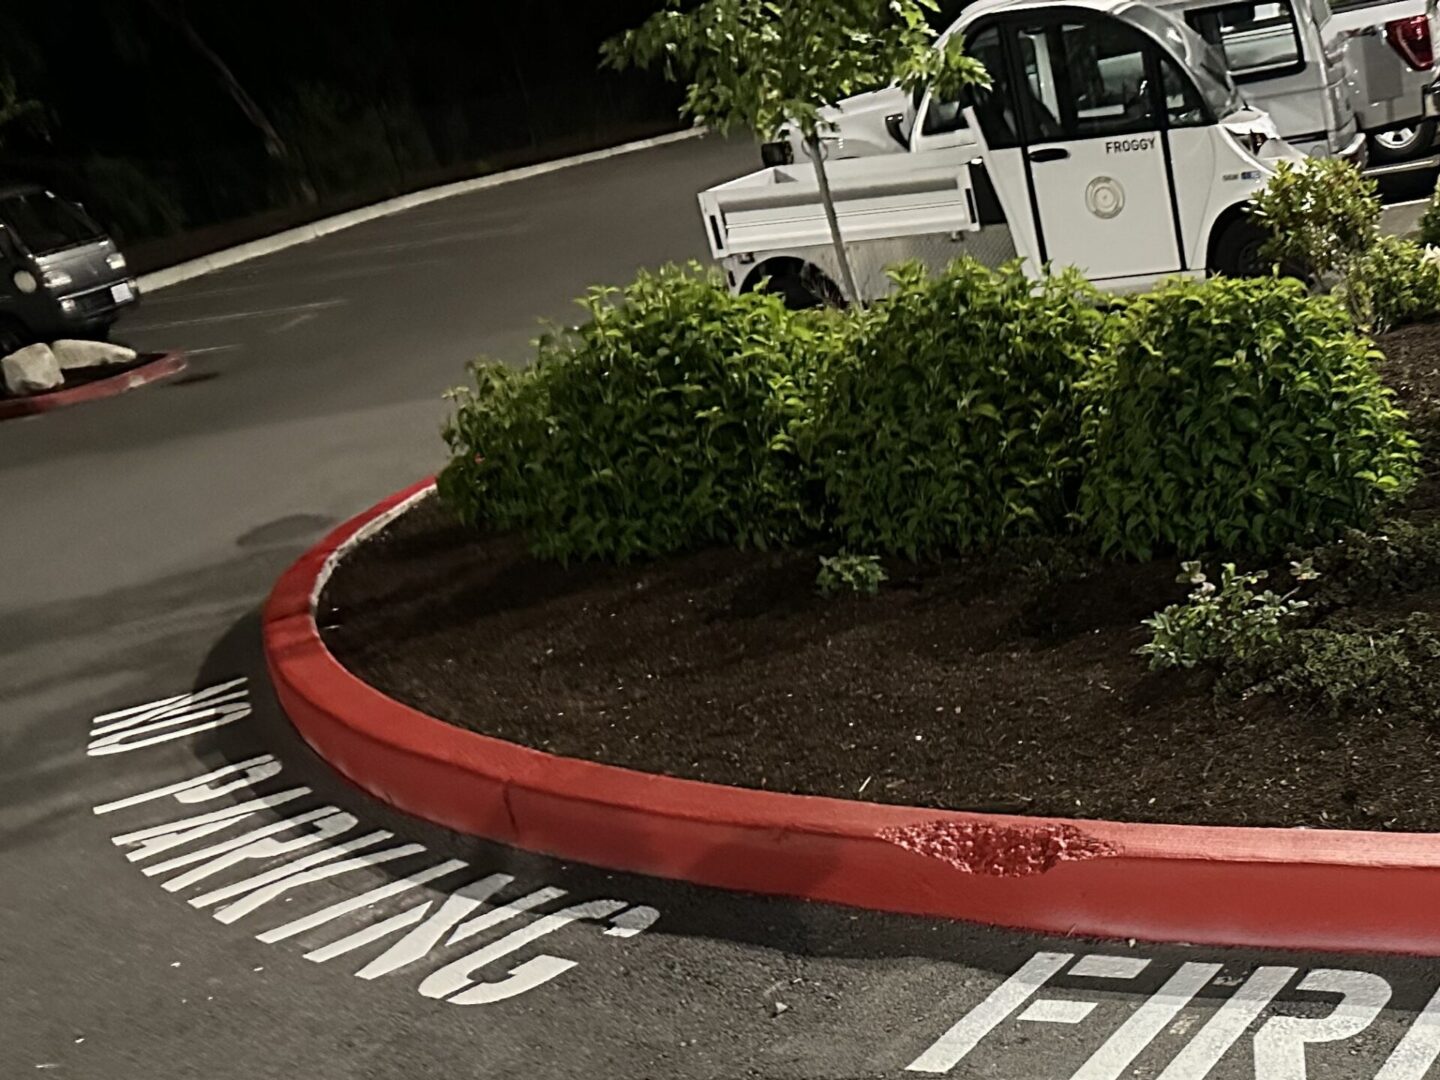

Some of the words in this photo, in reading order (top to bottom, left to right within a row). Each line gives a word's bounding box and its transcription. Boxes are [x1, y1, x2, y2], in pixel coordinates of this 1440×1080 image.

[1105, 137, 1156, 154] FROGGY
[87, 677, 252, 757] NO
[92, 754, 660, 1006] PARKING
